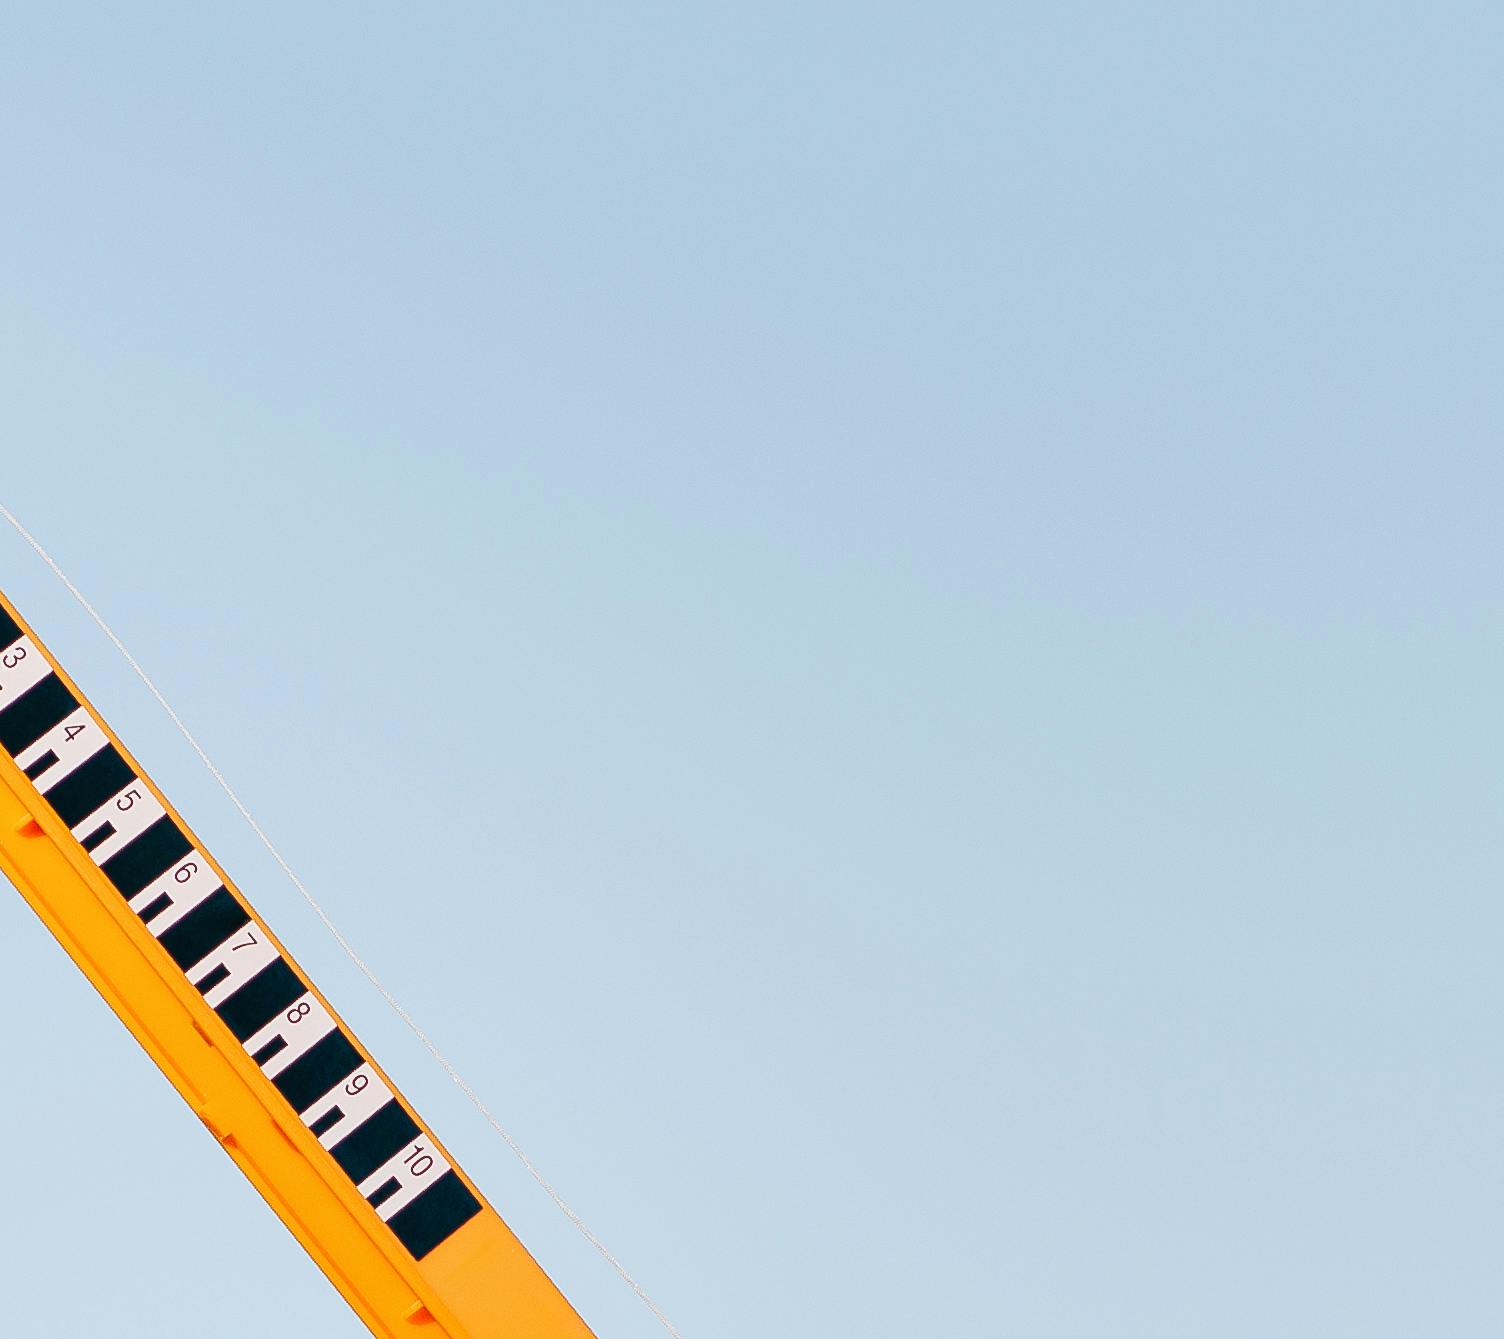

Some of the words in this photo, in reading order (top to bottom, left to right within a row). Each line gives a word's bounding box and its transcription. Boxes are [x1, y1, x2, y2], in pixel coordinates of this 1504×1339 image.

[2, 646, 27, 669] 3
[64, 724, 88, 745] 4
[116, 789, 142, 812] 5
[174, 862, 198, 884] 6
[231, 931, 258, 952] 7
[286, 1001, 311, 1024] 8
[344, 1074, 369, 1096] 9
[403, 1144, 434, 1177] 10
